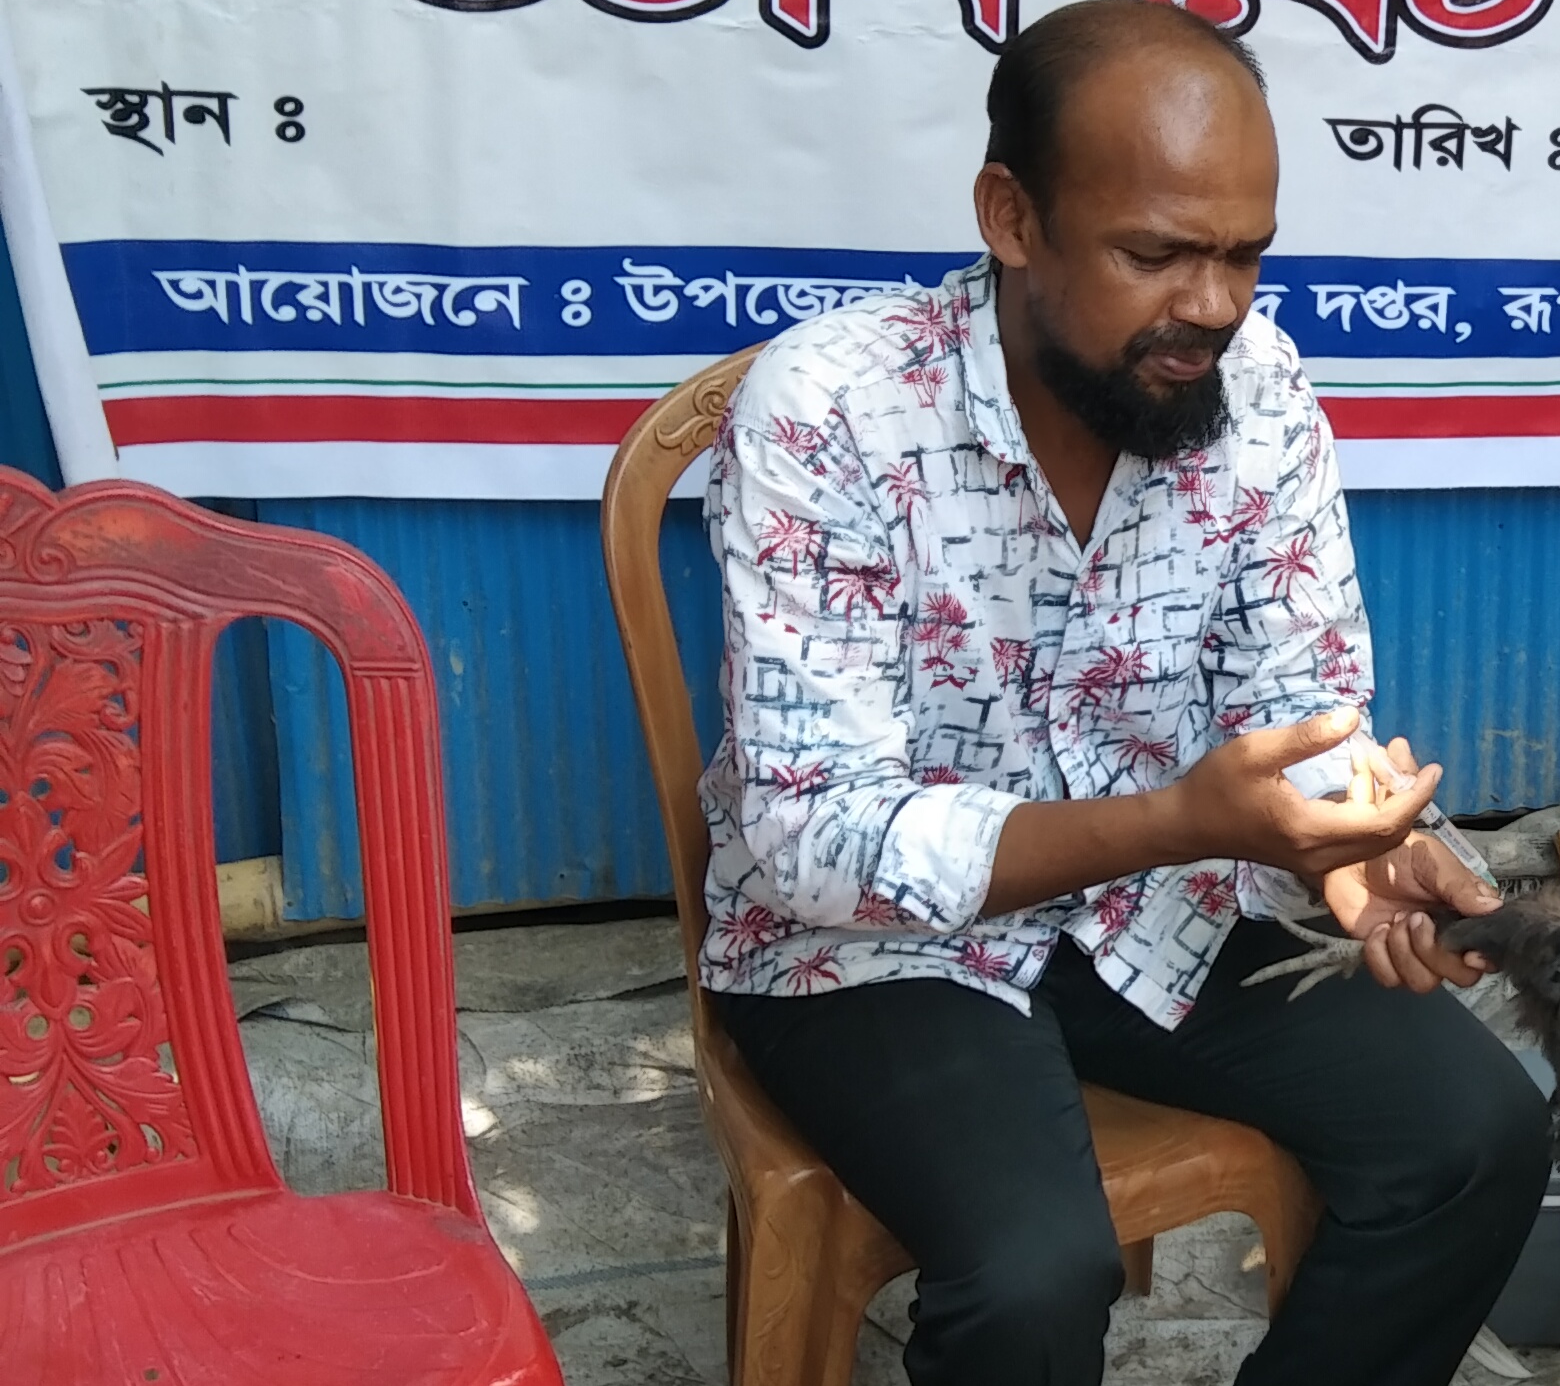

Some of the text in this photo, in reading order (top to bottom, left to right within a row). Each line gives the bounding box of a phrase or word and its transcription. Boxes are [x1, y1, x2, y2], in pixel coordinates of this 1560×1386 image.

[80, 81, 239, 157] স্থান
[1323, 104, 1522, 172] তারিখ
[153, 264, 528, 330] আয়োজনে
[1307, 279, 1472, 343] দপ্তর,
